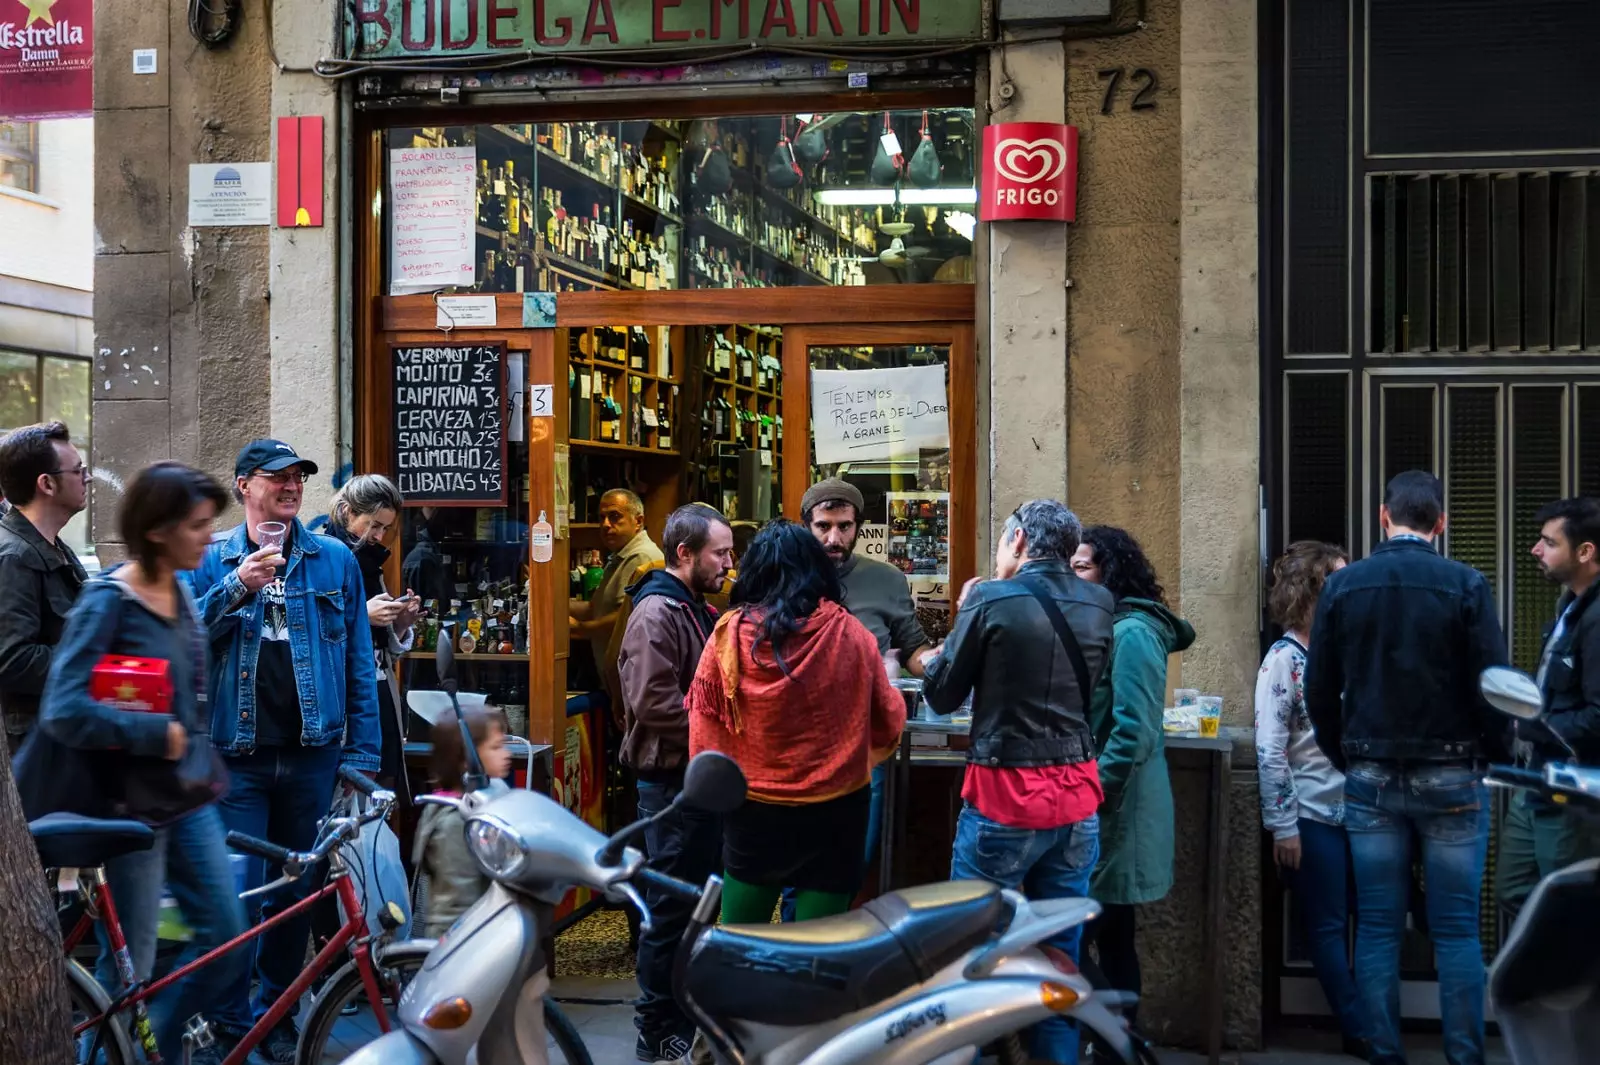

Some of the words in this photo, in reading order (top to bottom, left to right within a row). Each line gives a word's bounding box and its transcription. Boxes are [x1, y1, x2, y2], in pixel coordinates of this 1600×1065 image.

[0, 20, 84, 49] Estrella
[356, 0, 619, 51] BODEGA
[21, 47, 60, 61] Damm
[1099, 67, 1157, 114] 72
[997, 189, 1058, 206] FRIGO
[396, 363, 462, 383] MOJITO
[397, 384, 478, 407] CAIPIRIÑA
[534, 389, 546, 411] 3
[823, 386, 892, 406] TENEMOS
[398, 409, 474, 429] CERVEZA
[830, 407, 886, 427] RIBERA
[398, 430, 473, 449] SANGRIA
[842, 430, 850, 441] A
[854, 425, 901, 439] GRANEL
[398, 472, 476, 493] CUBATAS
